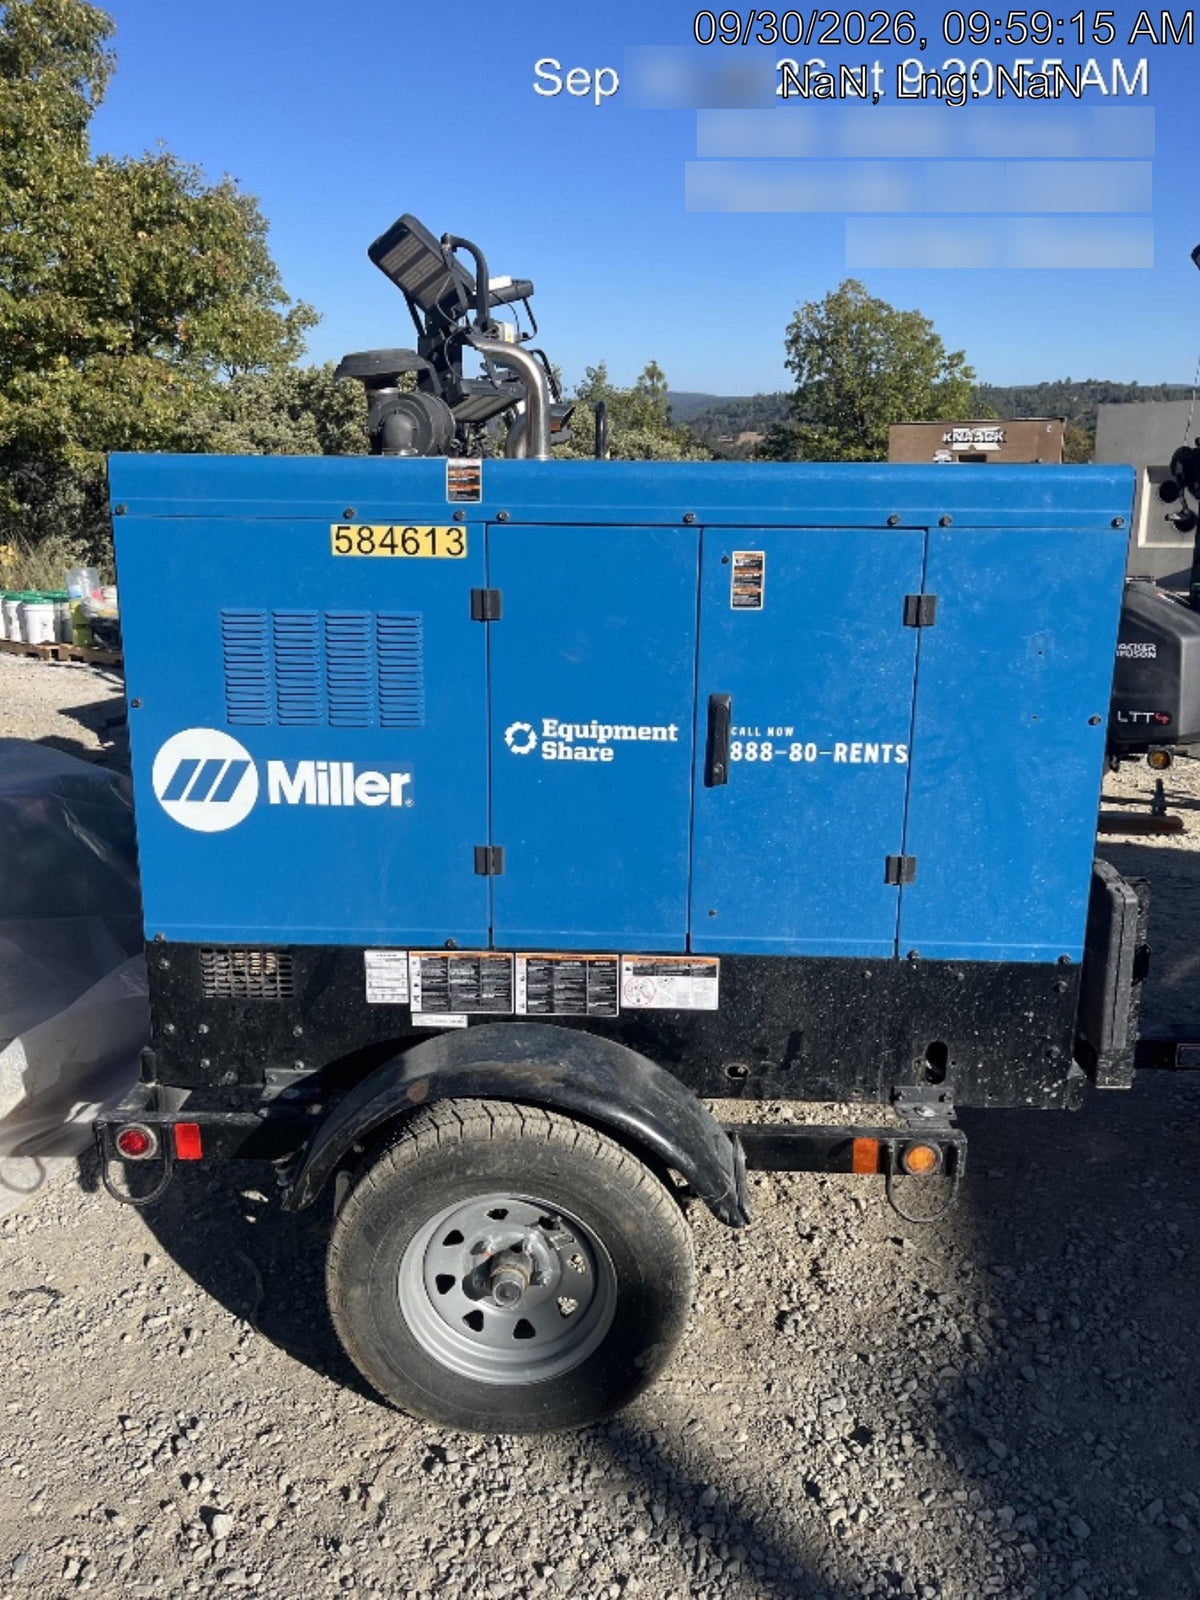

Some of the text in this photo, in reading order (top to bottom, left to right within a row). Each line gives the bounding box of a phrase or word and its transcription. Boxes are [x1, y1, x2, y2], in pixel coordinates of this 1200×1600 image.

[942, 430, 1006, 443] KNAACK
[334, 525, 465, 556] 584613
[541, 718, 679, 743] Equipment
[730, 726, 795, 737] CALL NOW
[541, 740, 615, 762] Share
[730, 740, 909, 763] 888-80-RENTS
